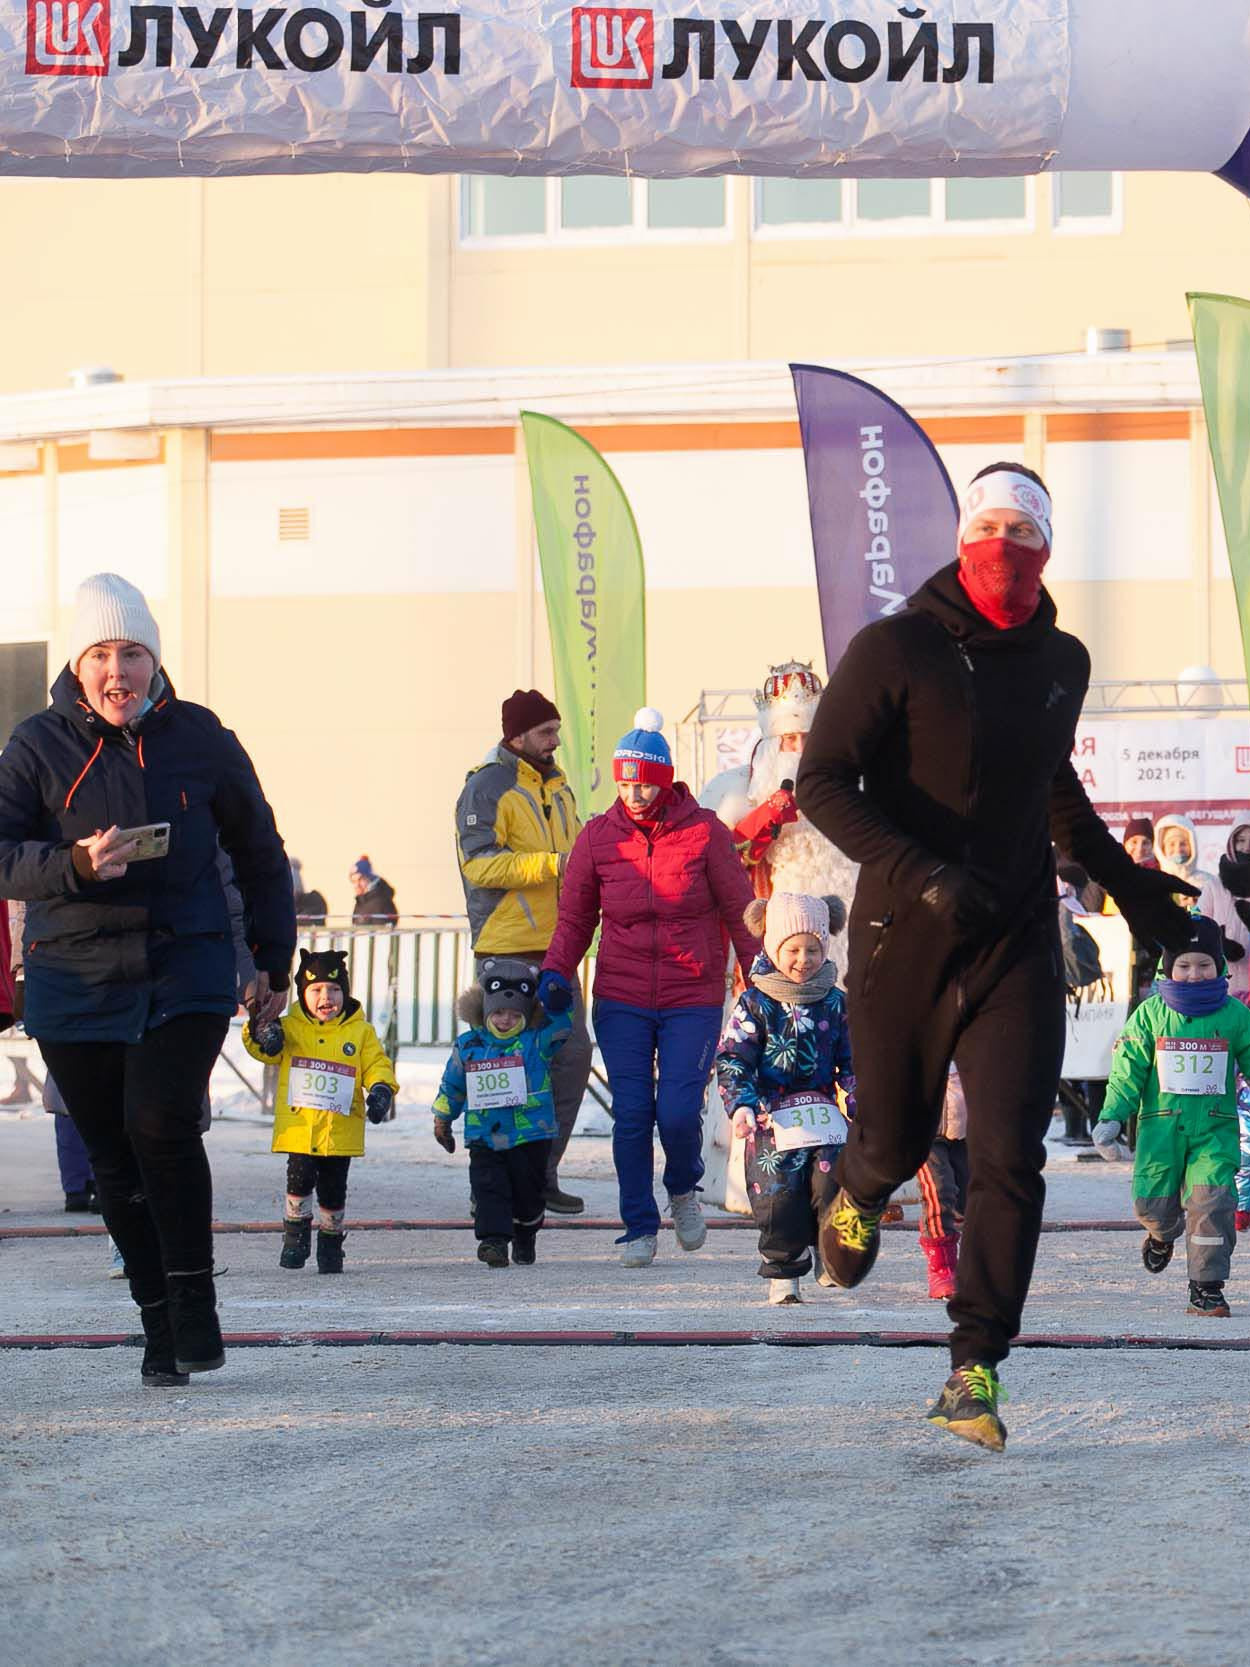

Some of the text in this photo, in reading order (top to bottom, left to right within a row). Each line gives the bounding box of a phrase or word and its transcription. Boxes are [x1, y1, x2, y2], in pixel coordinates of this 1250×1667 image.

[117, 0, 461, 75] ЛУКОЙЛ
[661, 4, 995, 84] ЛУКОЙЛ
[1137, 747, 1200, 764] декабря
[1138, 768, 1171, 781] 2021
[1179, 1041, 1198, 1050] 300
[309, 1061, 327, 1071] 300
[477, 1062, 492, 1070] 300
[1173, 1055, 1214, 1074] 312
[302, 1072, 338, 1094] 303
[476, 1072, 510, 1092] 308
[793, 1095, 813, 1106] 300
[790, 1106, 832, 1127] 313
